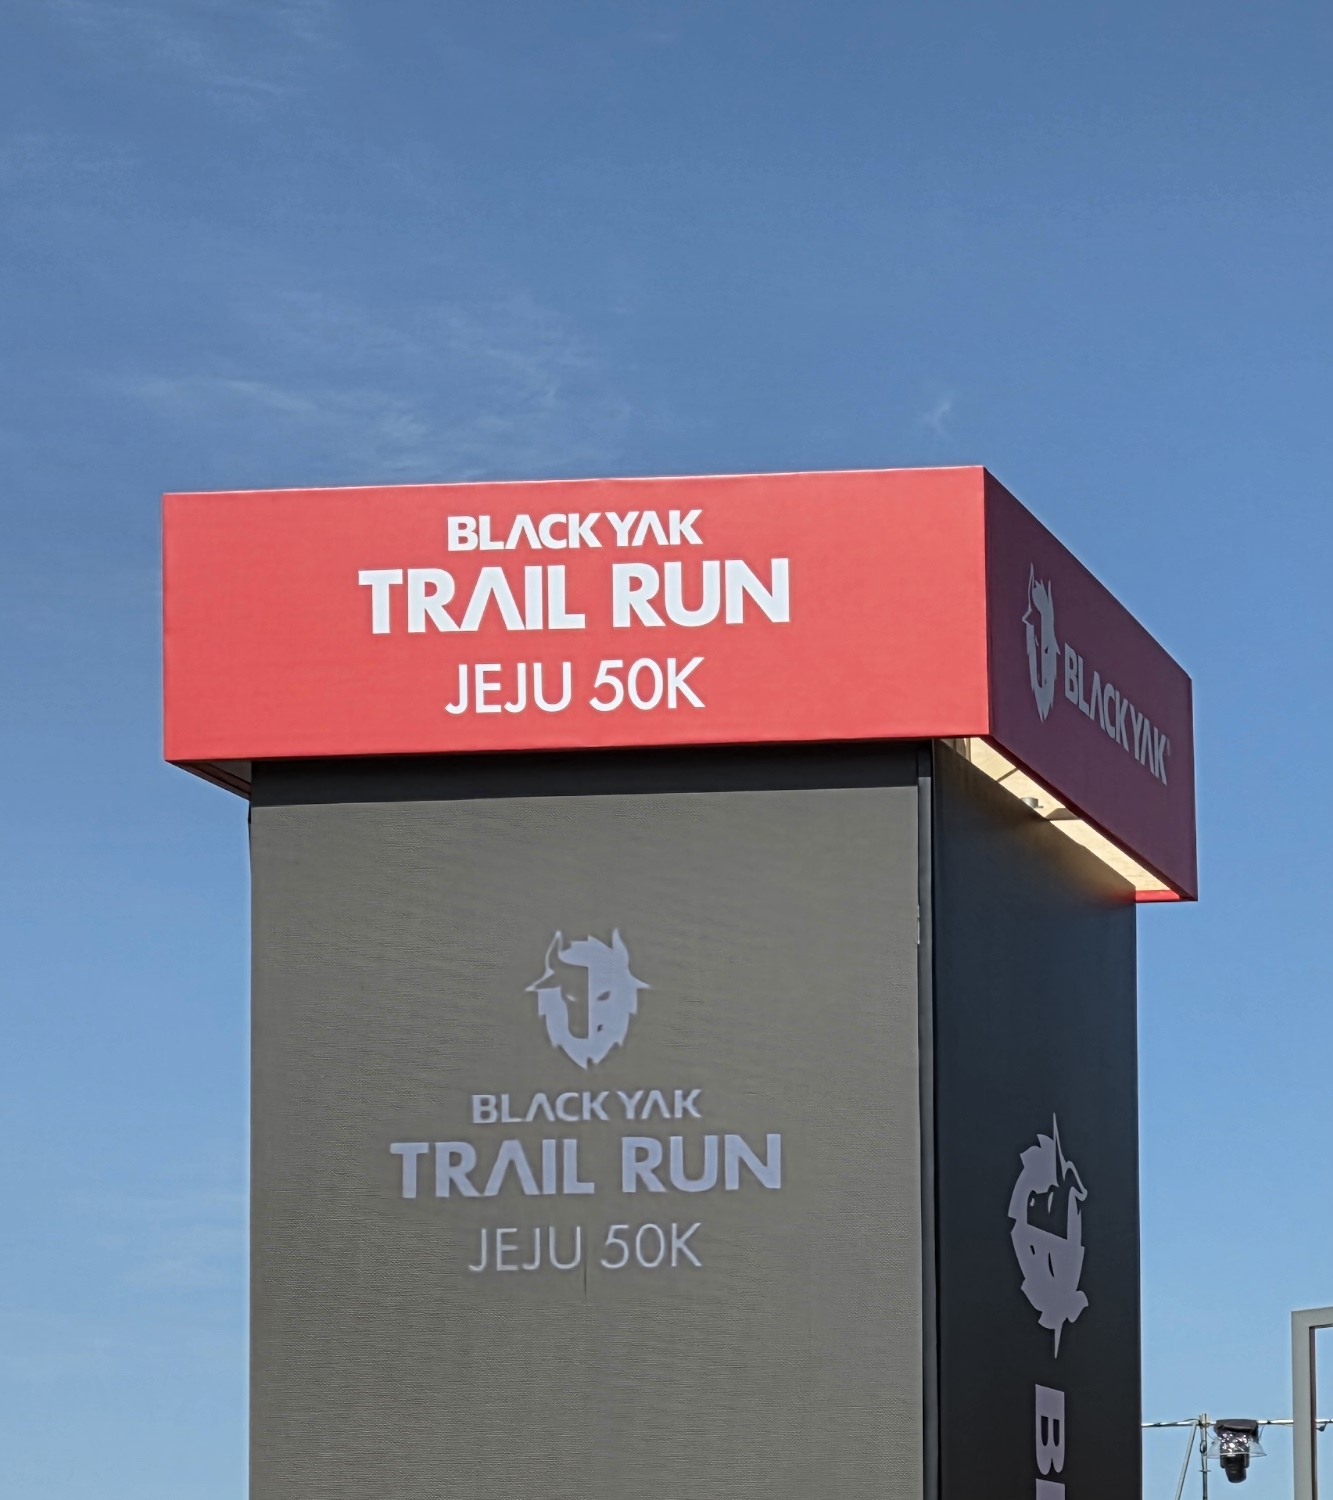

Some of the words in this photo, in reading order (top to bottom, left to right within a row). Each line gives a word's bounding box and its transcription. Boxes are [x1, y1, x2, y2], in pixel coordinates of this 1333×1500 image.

[358, 564, 586, 635] TRAIL
[612, 557, 790, 628] RUN
[445, 661, 572, 715] JEJU
[589, 656, 706, 712] 50K
[389, 1138, 595, 1199] TRAIL
[621, 1133, 782, 1193] RUN
[468, 1225, 581, 1272] JEJU
[601, 1222, 702, 1269] 50K
